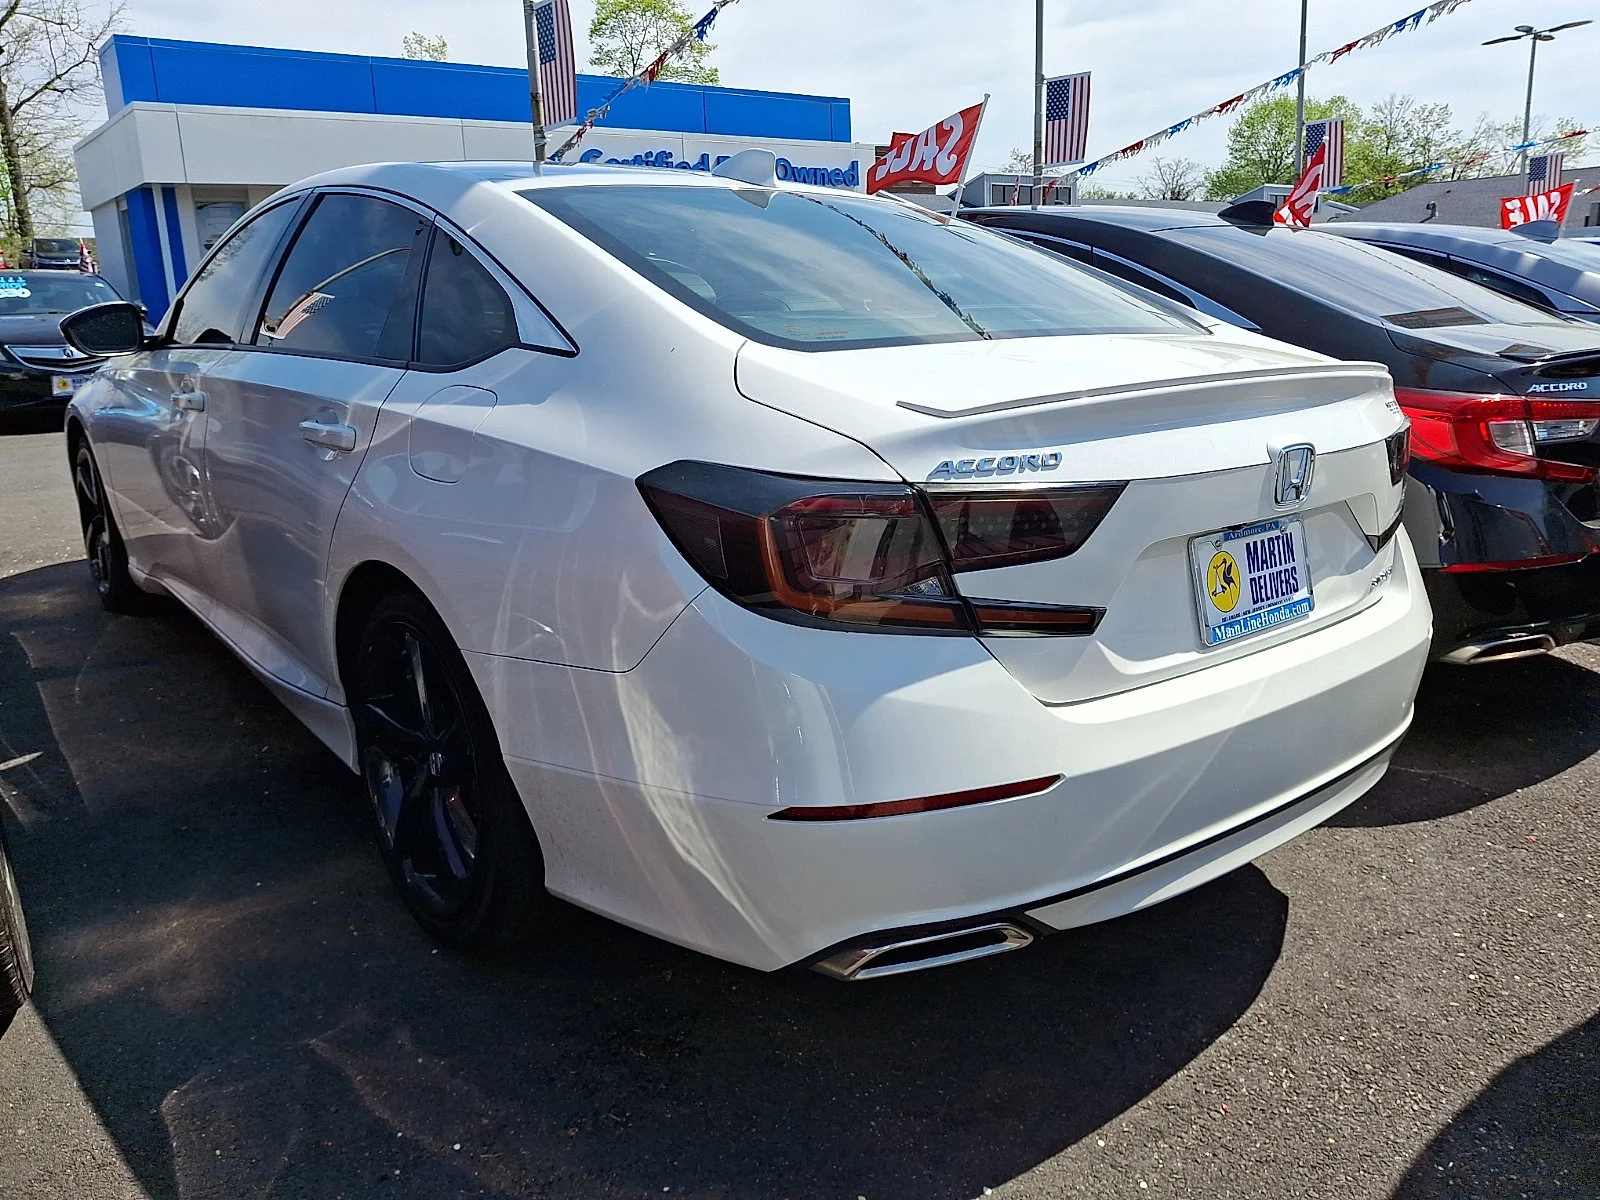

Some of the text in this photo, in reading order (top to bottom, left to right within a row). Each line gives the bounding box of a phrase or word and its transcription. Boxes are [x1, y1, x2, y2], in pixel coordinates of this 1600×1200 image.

[776, 158, 860, 187] Owned
[1527, 382, 1588, 393] ACCORD
[926, 452, 1063, 481] ACCORD
[1266, 522, 1276, 531] PA
[1245, 532, 1295, 574] MARTIN
[1249, 566, 1299, 605] DELIVERS
[1214, 601, 1310, 642] MainLineHonda.com
